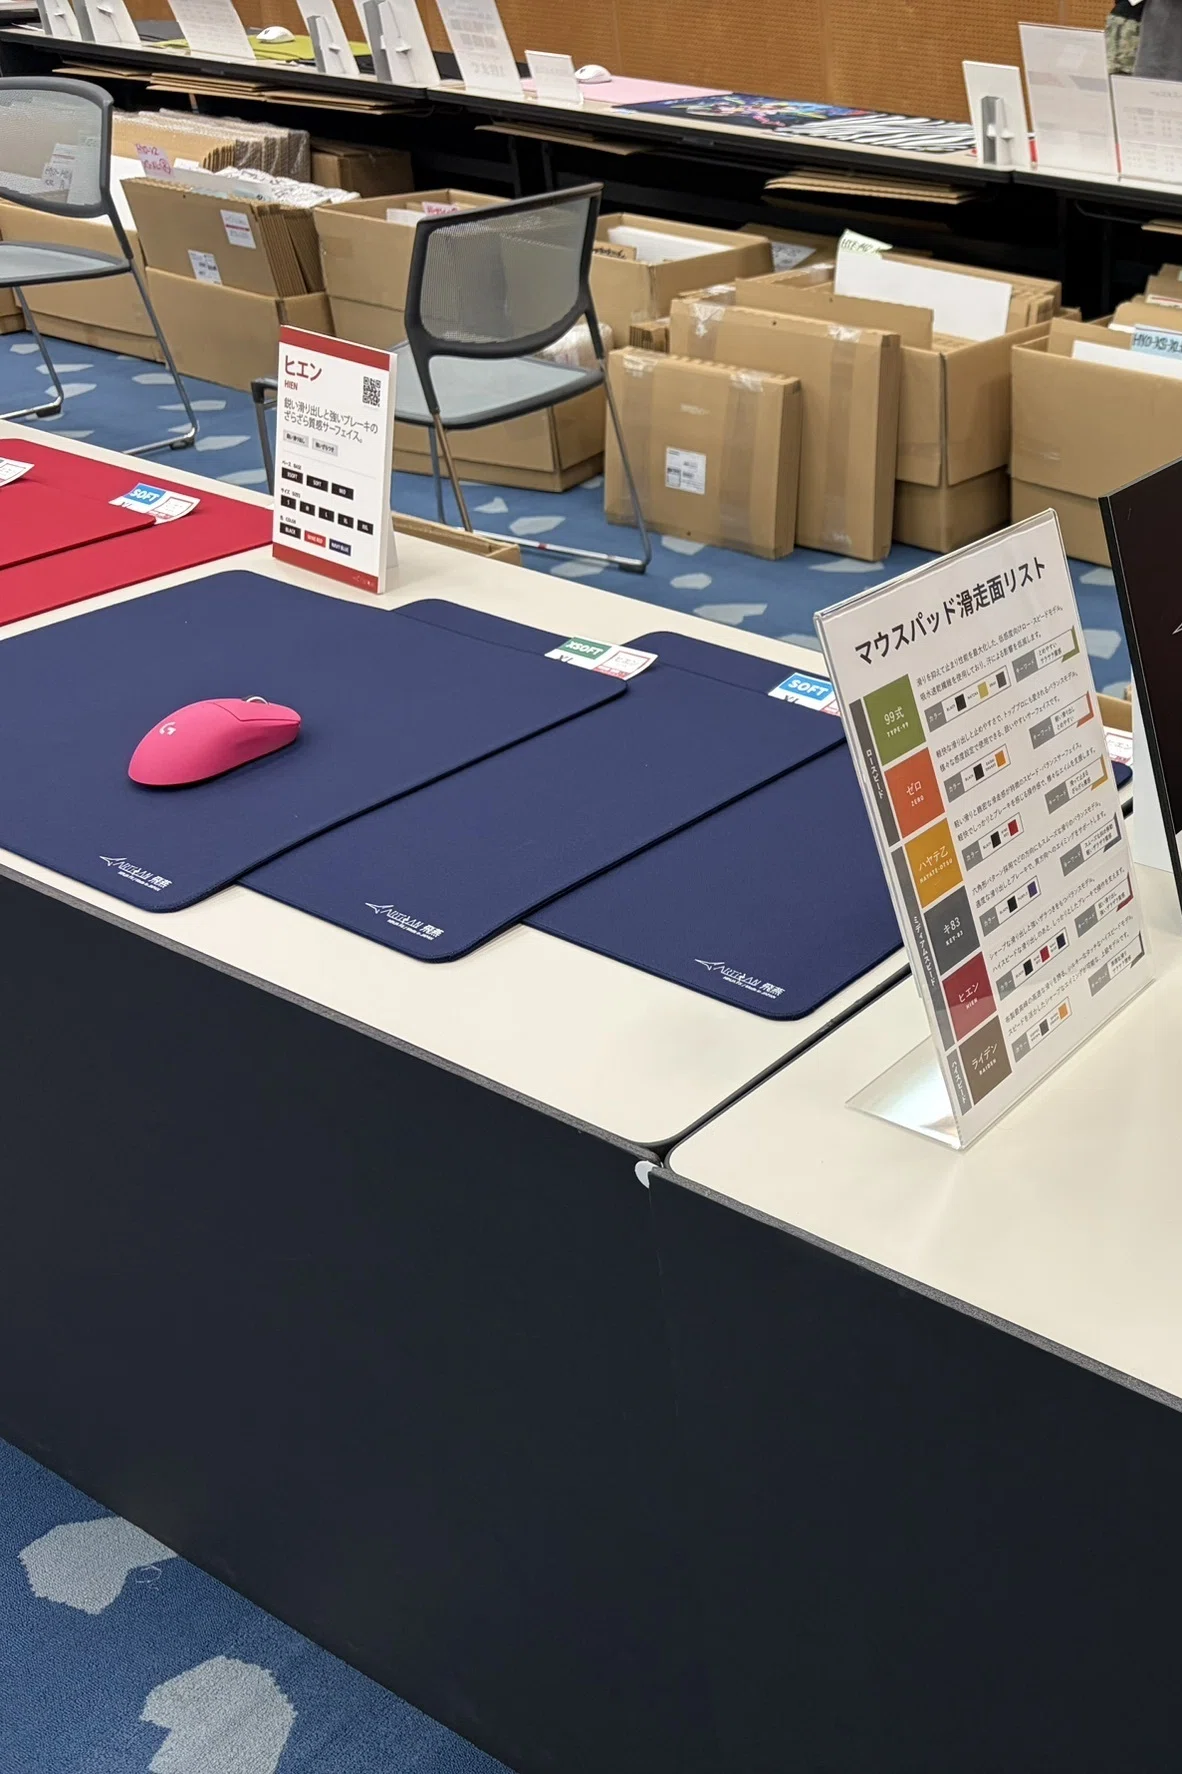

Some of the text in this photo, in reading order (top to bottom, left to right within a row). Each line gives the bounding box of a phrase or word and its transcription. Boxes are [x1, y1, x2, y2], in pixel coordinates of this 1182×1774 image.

[285, 355, 322, 381] ヒエン
[284, 379, 298, 390] HIEN
[284, 397, 378, 434] 鋭い滑り出しと強いブレーキの
[284, 411, 363, 443] ざらざら質感サーフェイス。
[129, 488, 160, 502] SOFT
[285, 527, 296, 535] BLACK
[855, 556, 1046, 665] マウスパッド滑走面リスト
[566, 640, 604, 656] XSOFT
[788, 679, 829, 696] SOFT
[883, 705, 904, 726] 99式
[927, 708, 942, 722] カラー
[886, 721, 909, 738] TYPE-99
[866, 747, 884, 800] ロースピード
[905, 779, 922, 797] ゼロ
[948, 780, 961, 793] カラー
[910, 794, 924, 806] ZERO
[917, 844, 948, 872] ハヤテ乙
[965, 848, 979, 861] カラー
[919, 857, 953, 883] HAYATE-OTSU
[380, 909, 424, 928] ARTISAN
[942, 916, 960, 936] キ83
[983, 914, 995, 927] カラー
[945, 929, 963, 946] KEY-83
[912, 915, 935, 987] ミディアムスピード
[713, 965, 762, 987] ARTISAN
[1000, 978, 1012, 991] カラー
[958, 980, 979, 1003] ヒエン
[965, 997, 977, 1009] HIEN
[1015, 1040, 1027, 1052] カラー
[971, 1040, 998, 1070] ライデン
[979, 1058, 996, 1075] RAIDEN
[951, 1060, 966, 1104] ハイスピード
